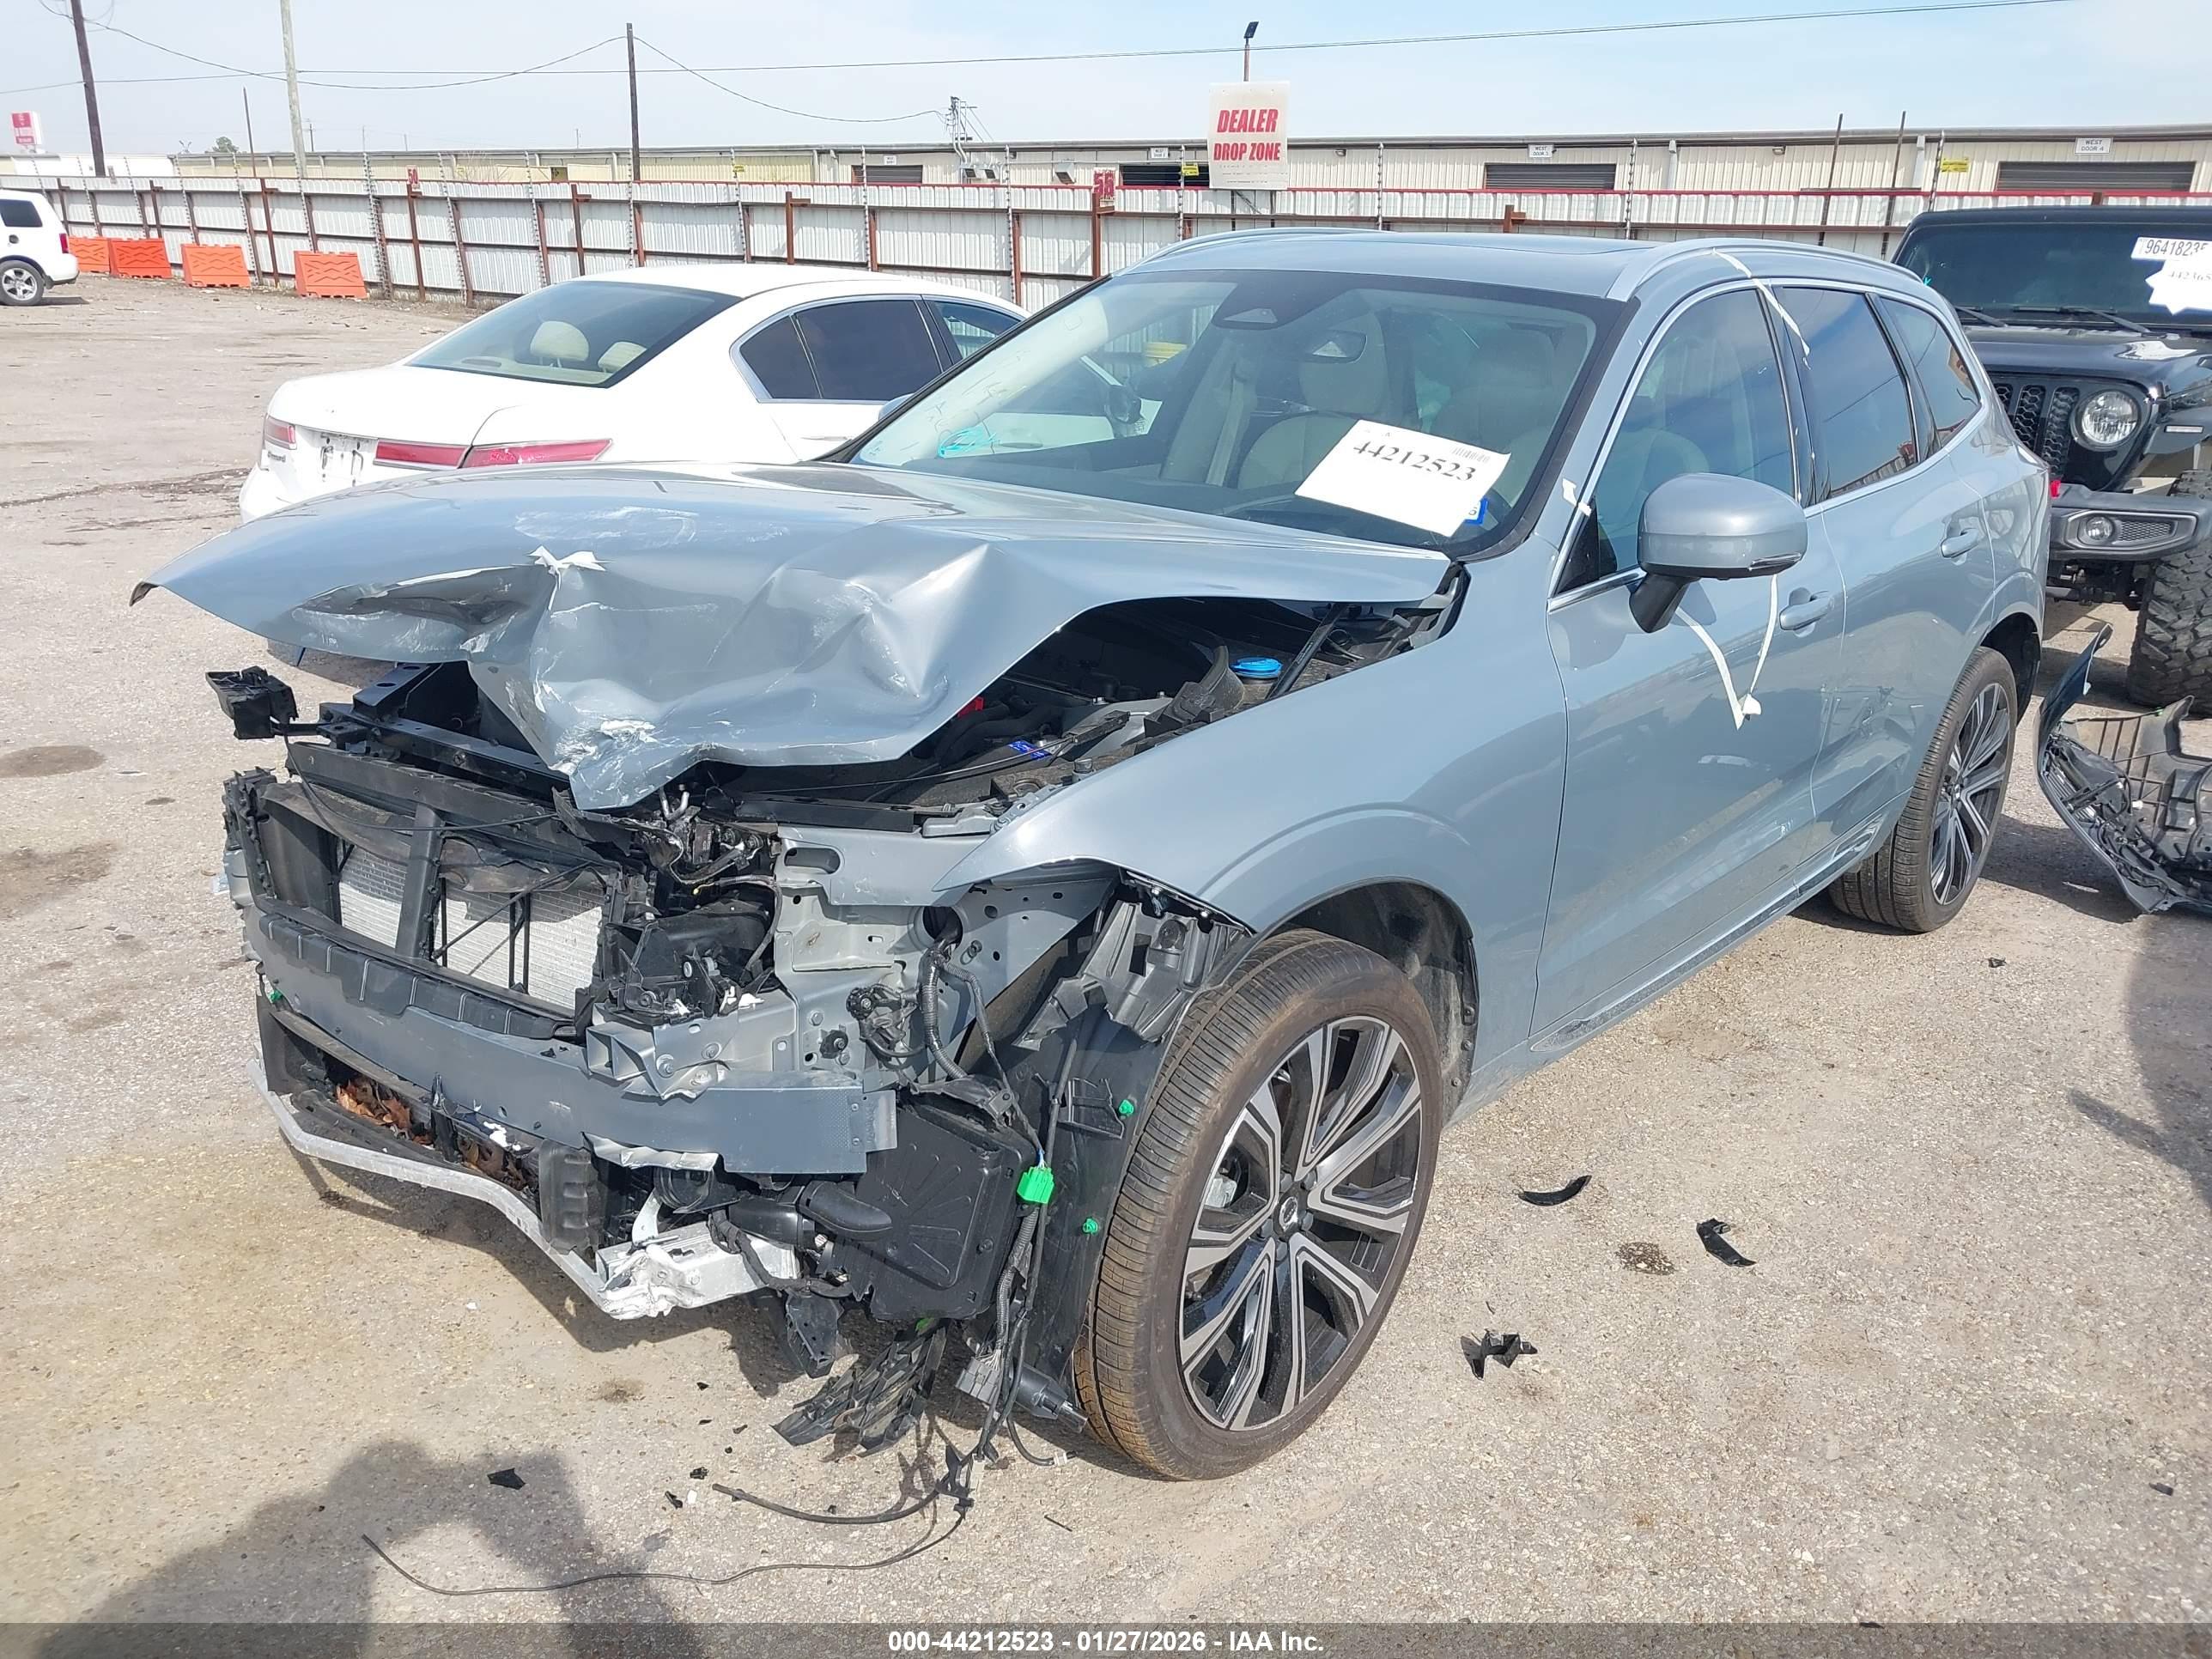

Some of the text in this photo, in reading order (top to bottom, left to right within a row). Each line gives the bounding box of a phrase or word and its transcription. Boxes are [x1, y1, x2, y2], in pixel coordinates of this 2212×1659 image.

[1217, 109, 1279, 133] DEALER
[1213, 143, 1282, 161] DROP ZONE
[1352, 441, 1476, 481] 44212523
